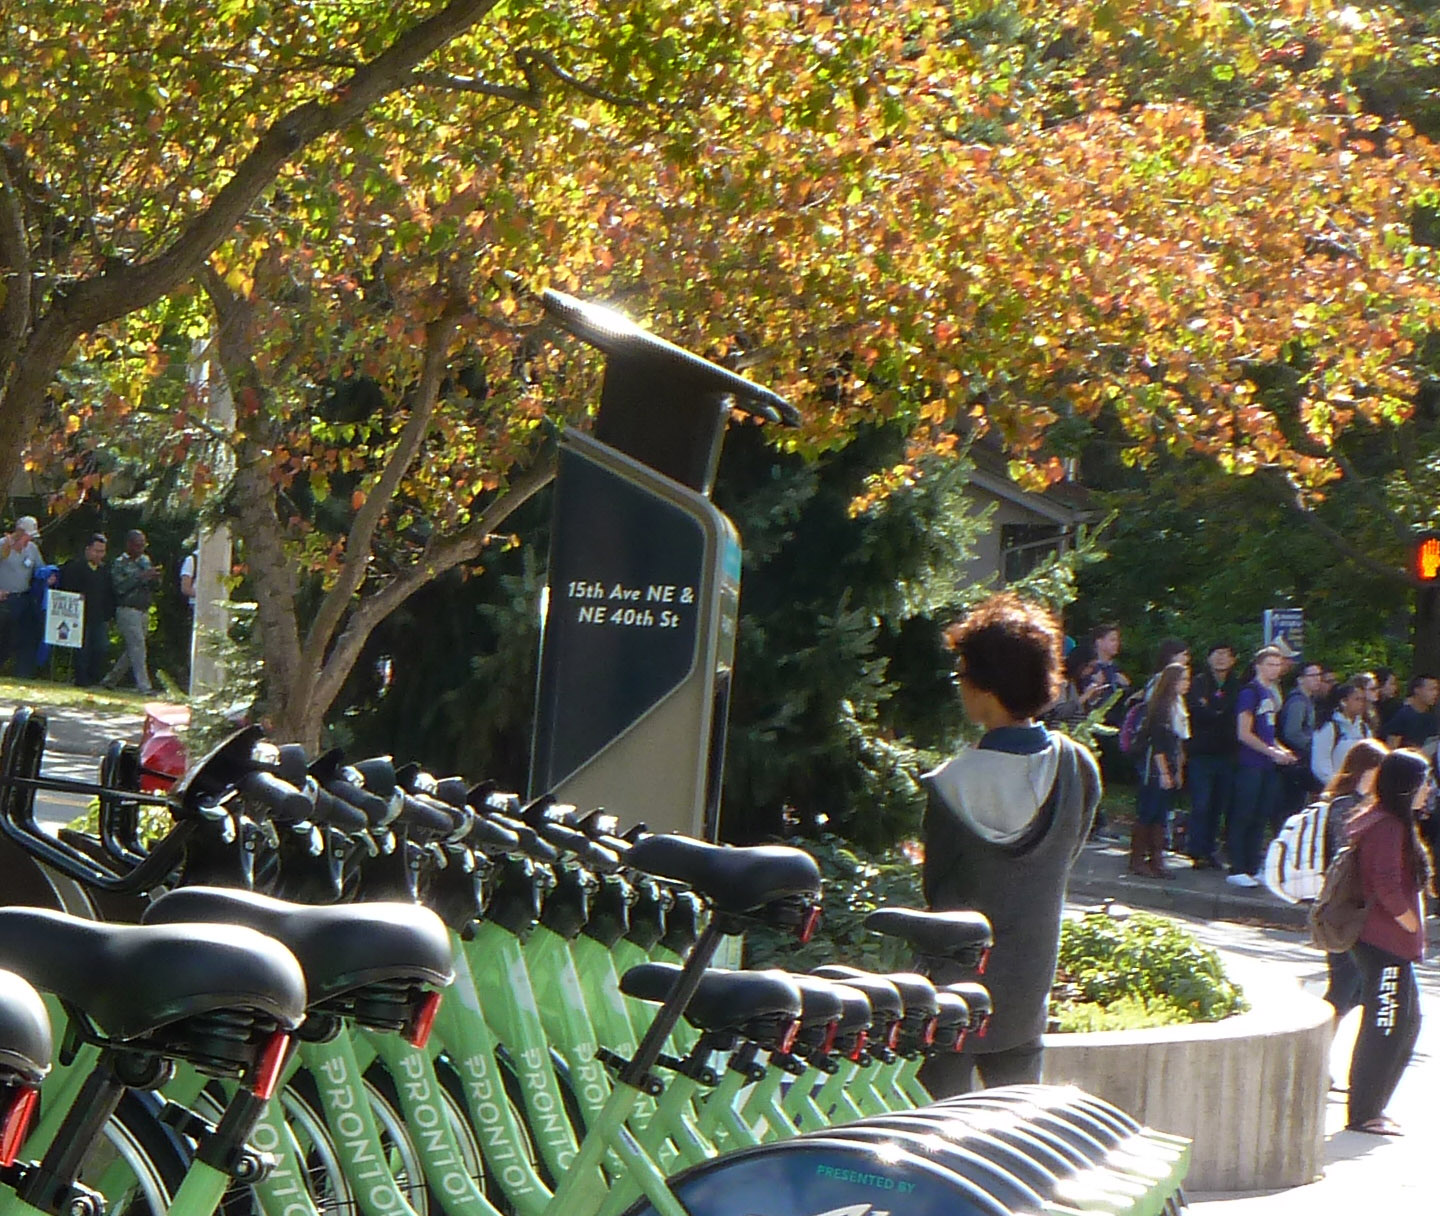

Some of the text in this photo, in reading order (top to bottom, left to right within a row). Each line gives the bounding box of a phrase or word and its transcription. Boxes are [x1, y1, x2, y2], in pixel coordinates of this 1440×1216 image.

[569, 581, 694, 604] 15th Ave NE &
[578, 606, 680, 628] NE 40th St
[399, 1053, 475, 1204] PRONTO!
[464, 1054, 533, 1195] PRONTO!
[521, 1048, 575, 1170] PRONTO
[816, 1164, 916, 1195] PRESENTED BY
